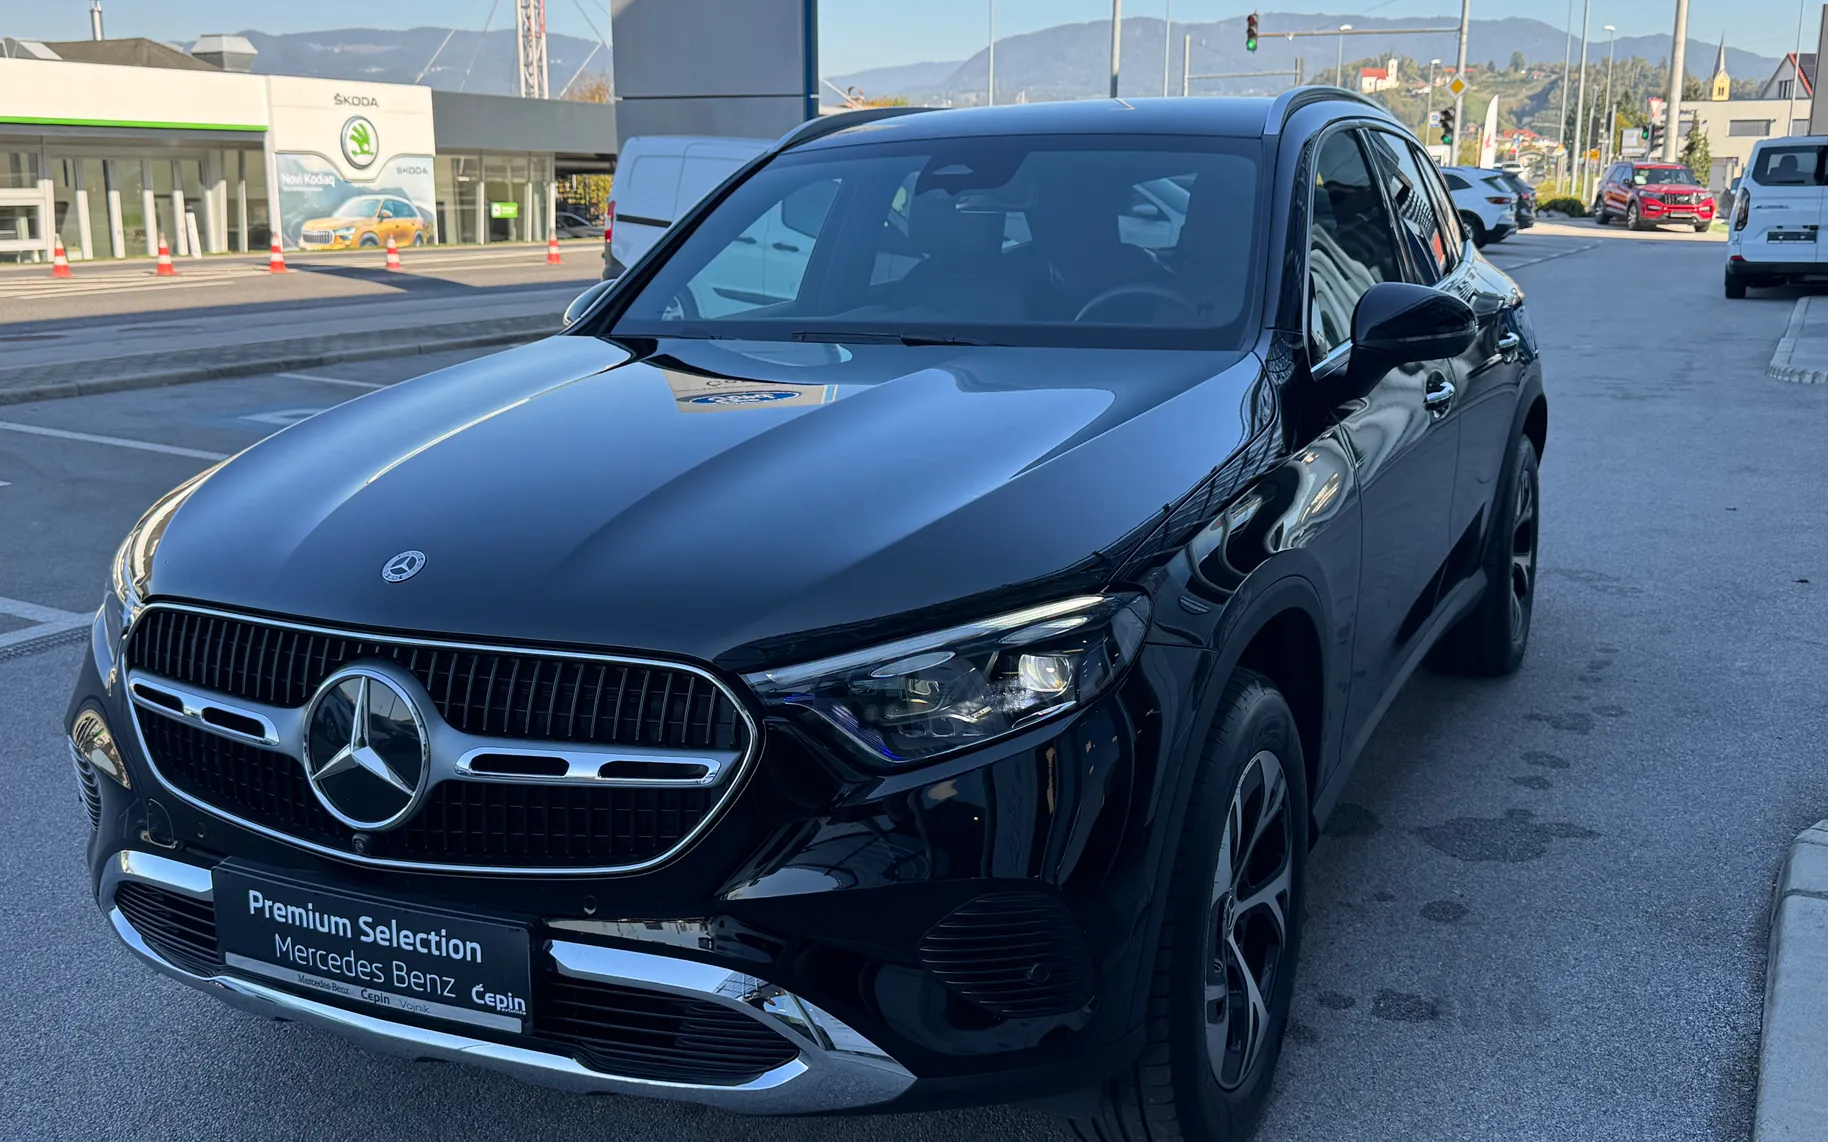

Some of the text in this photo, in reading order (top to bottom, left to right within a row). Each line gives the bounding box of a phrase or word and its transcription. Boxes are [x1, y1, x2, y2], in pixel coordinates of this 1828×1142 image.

[334, 93, 379, 107] ŠKODA
[248, 889, 482, 963] Premium Selection
[274, 932, 457, 998] Mercedes Benz
[400, 1000, 431, 1013] Vojnik
